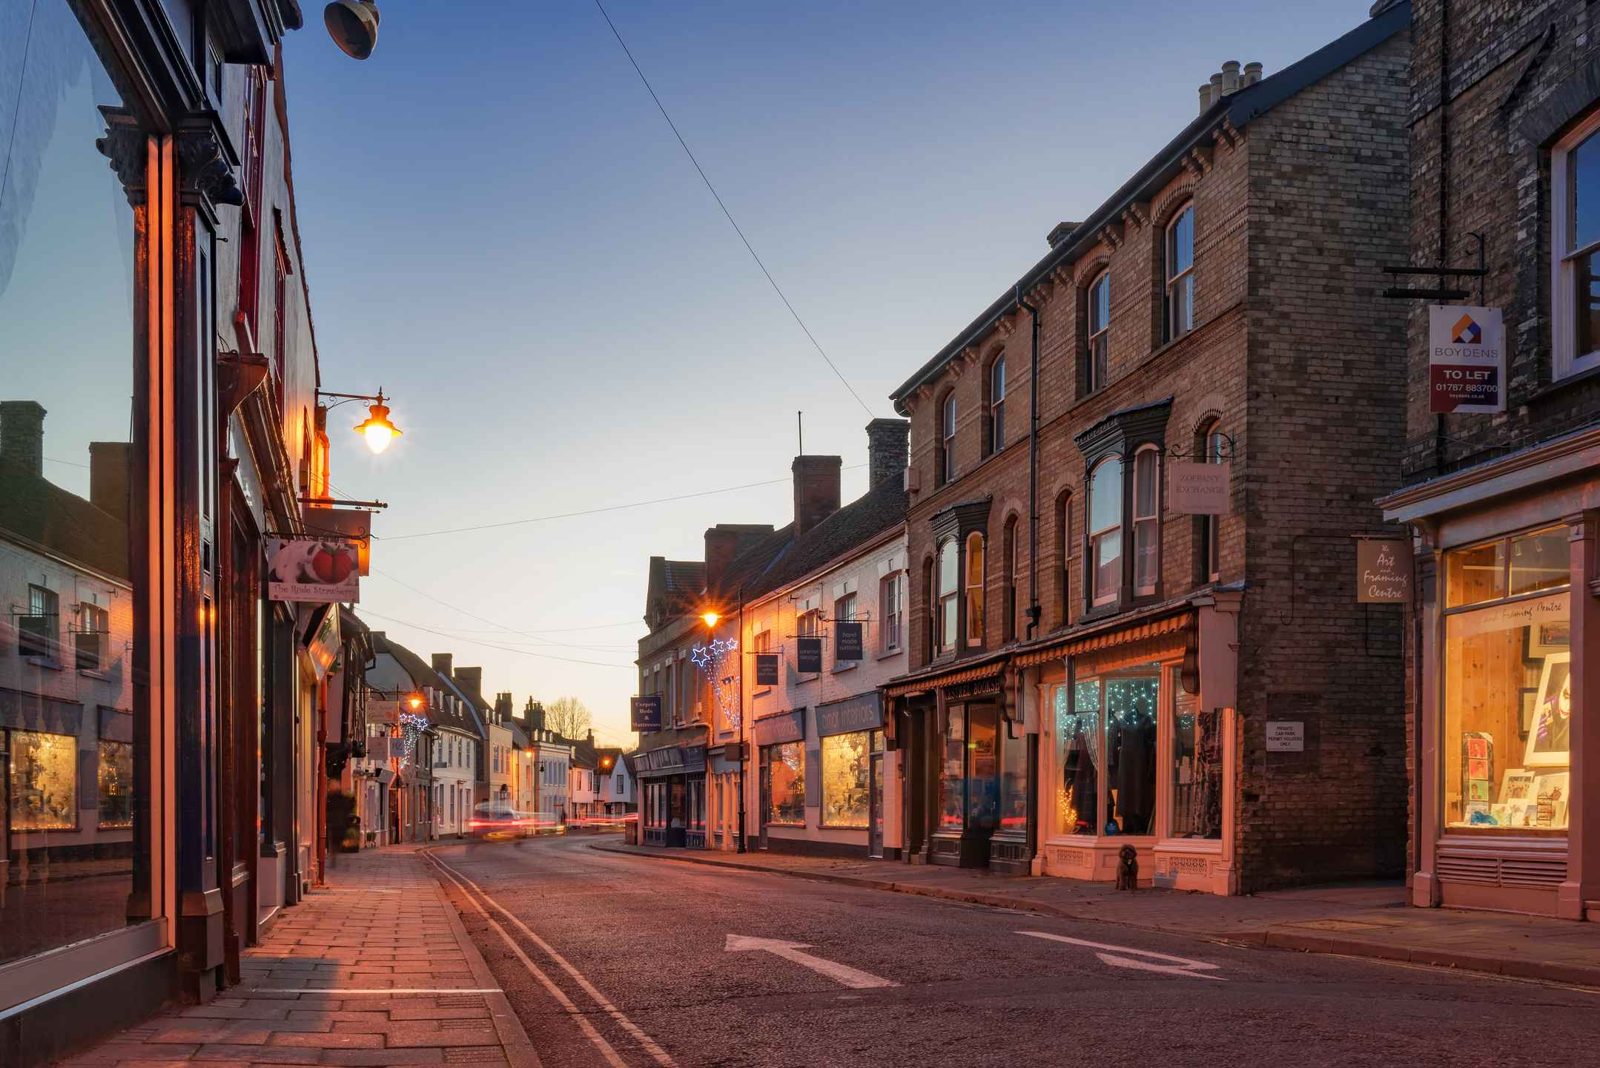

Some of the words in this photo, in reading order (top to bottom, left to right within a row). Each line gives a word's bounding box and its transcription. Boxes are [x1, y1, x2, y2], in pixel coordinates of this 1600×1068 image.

[1434, 347, 1499, 358] BOYDENS
[1443, 370, 1463, 380] TO
[1466, 371, 1491, 380] LET
[1436, 384, 1463, 392] 01787
[1465, 384, 1498, 393] 883700
[1377, 553, 1394, 566] Art
[1363, 570, 1408, 587] Framing
[1368, 585, 1403, 598] Centre
